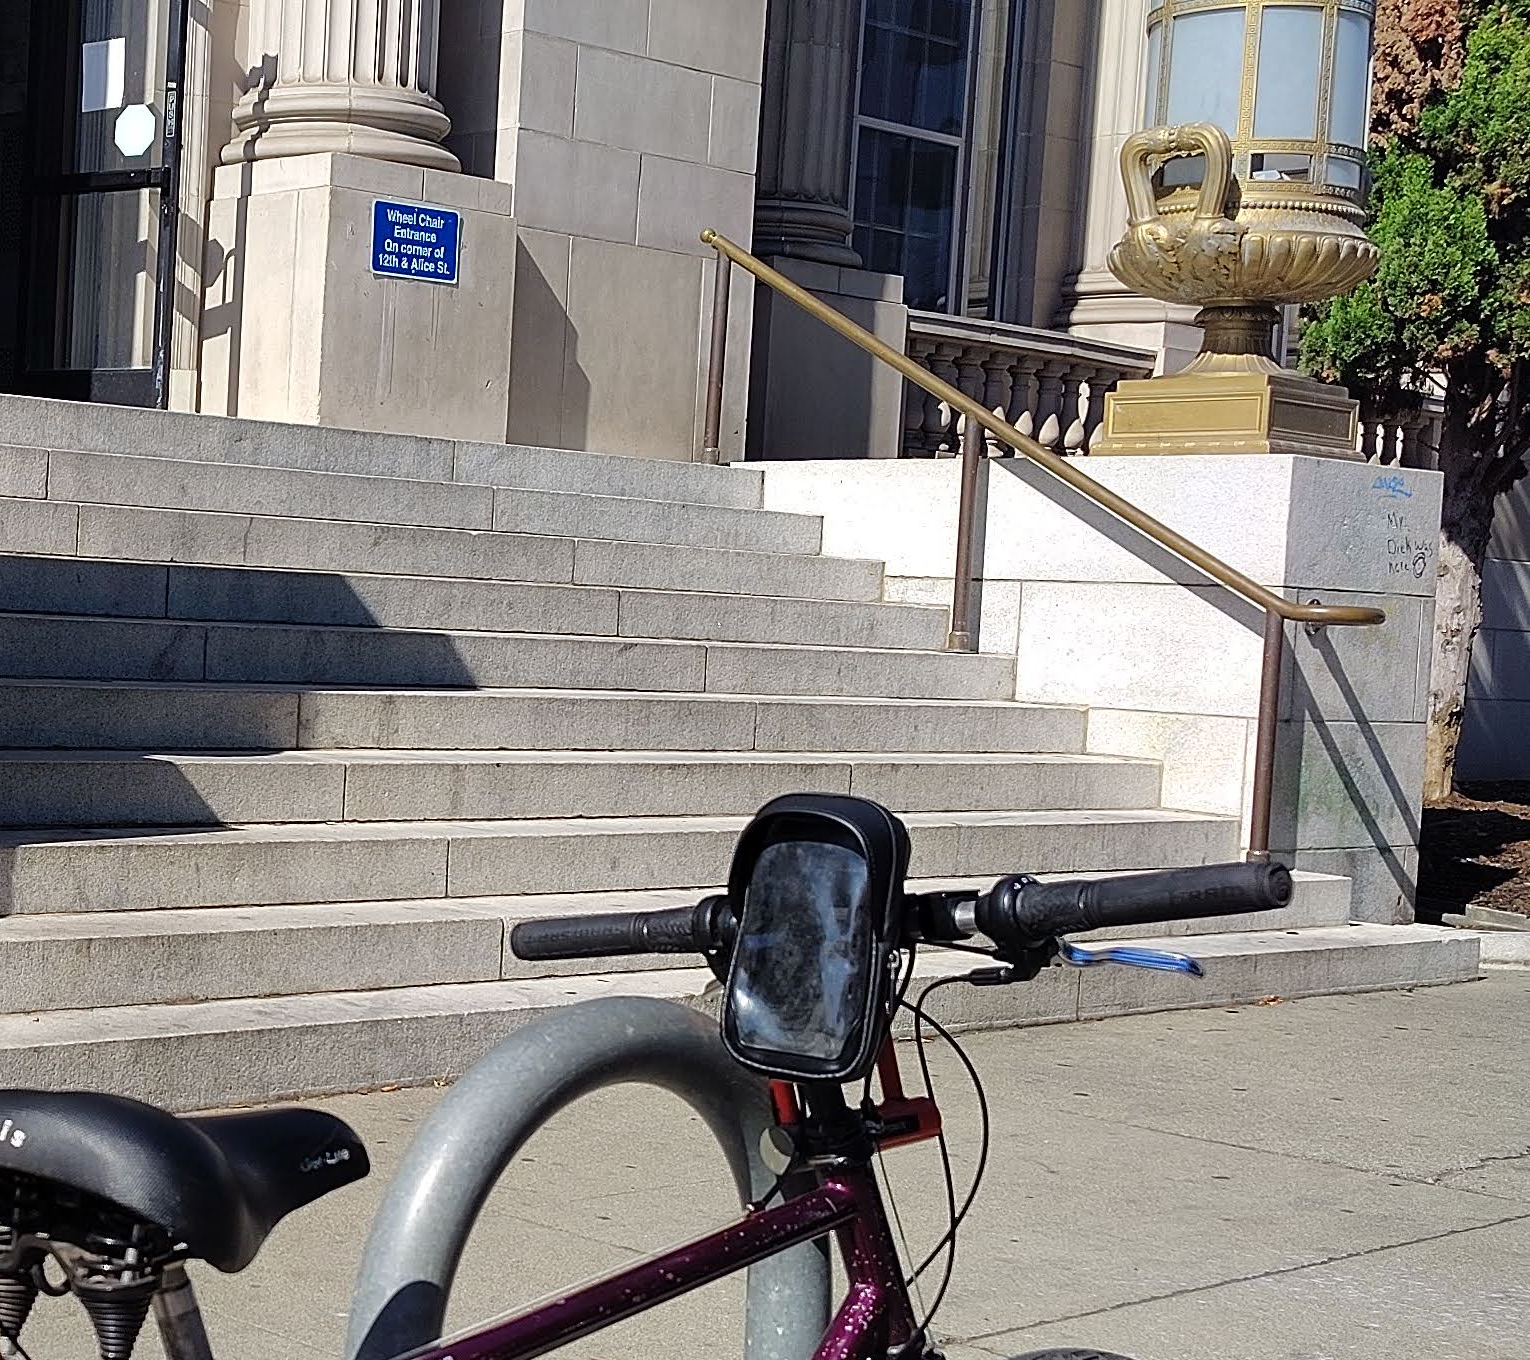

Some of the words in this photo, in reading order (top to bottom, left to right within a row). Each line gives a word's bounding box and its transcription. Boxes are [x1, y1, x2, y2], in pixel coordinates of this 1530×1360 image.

[386, 208, 417, 225] Wheel
[418, 213, 445, 229] Chair
[393, 225, 437, 243] Entrance
[384, 238, 399, 253] On
[400, 243, 432, 258] corner
[434, 246, 445, 259] of
[378, 253, 399, 268] 12th
[400, 256, 409, 269] &
[410, 257, 435, 272] Alice
[437, 261, 450, 275] St.
